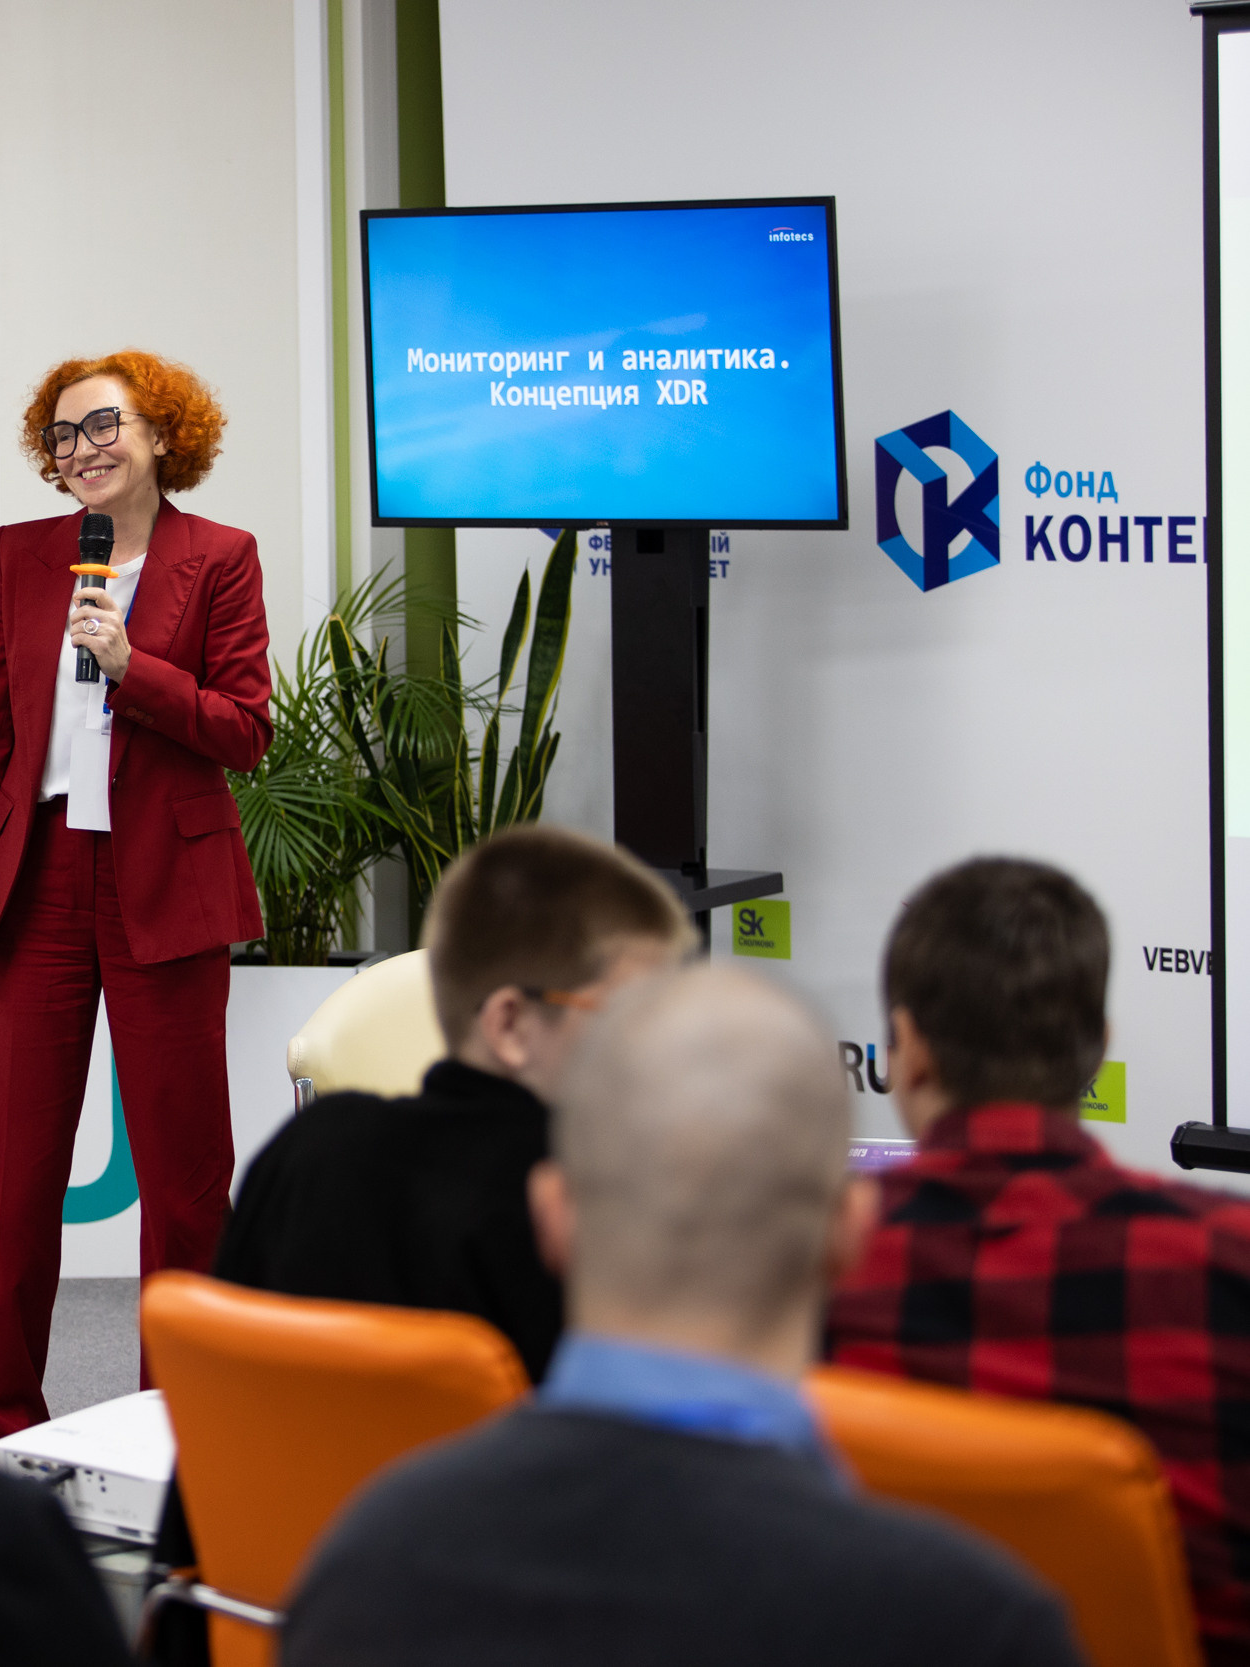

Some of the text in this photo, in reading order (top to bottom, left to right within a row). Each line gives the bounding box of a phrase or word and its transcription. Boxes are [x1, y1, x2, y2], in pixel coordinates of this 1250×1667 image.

[768, 230, 814, 242] infotecs
[407, 347, 790, 379] Мониторинг и аналитика.
[490, 379, 709, 410] Концепция XDR
[1024, 460, 1119, 504] Фонд
[1025, 514, 1207, 564] КОНТЕ
